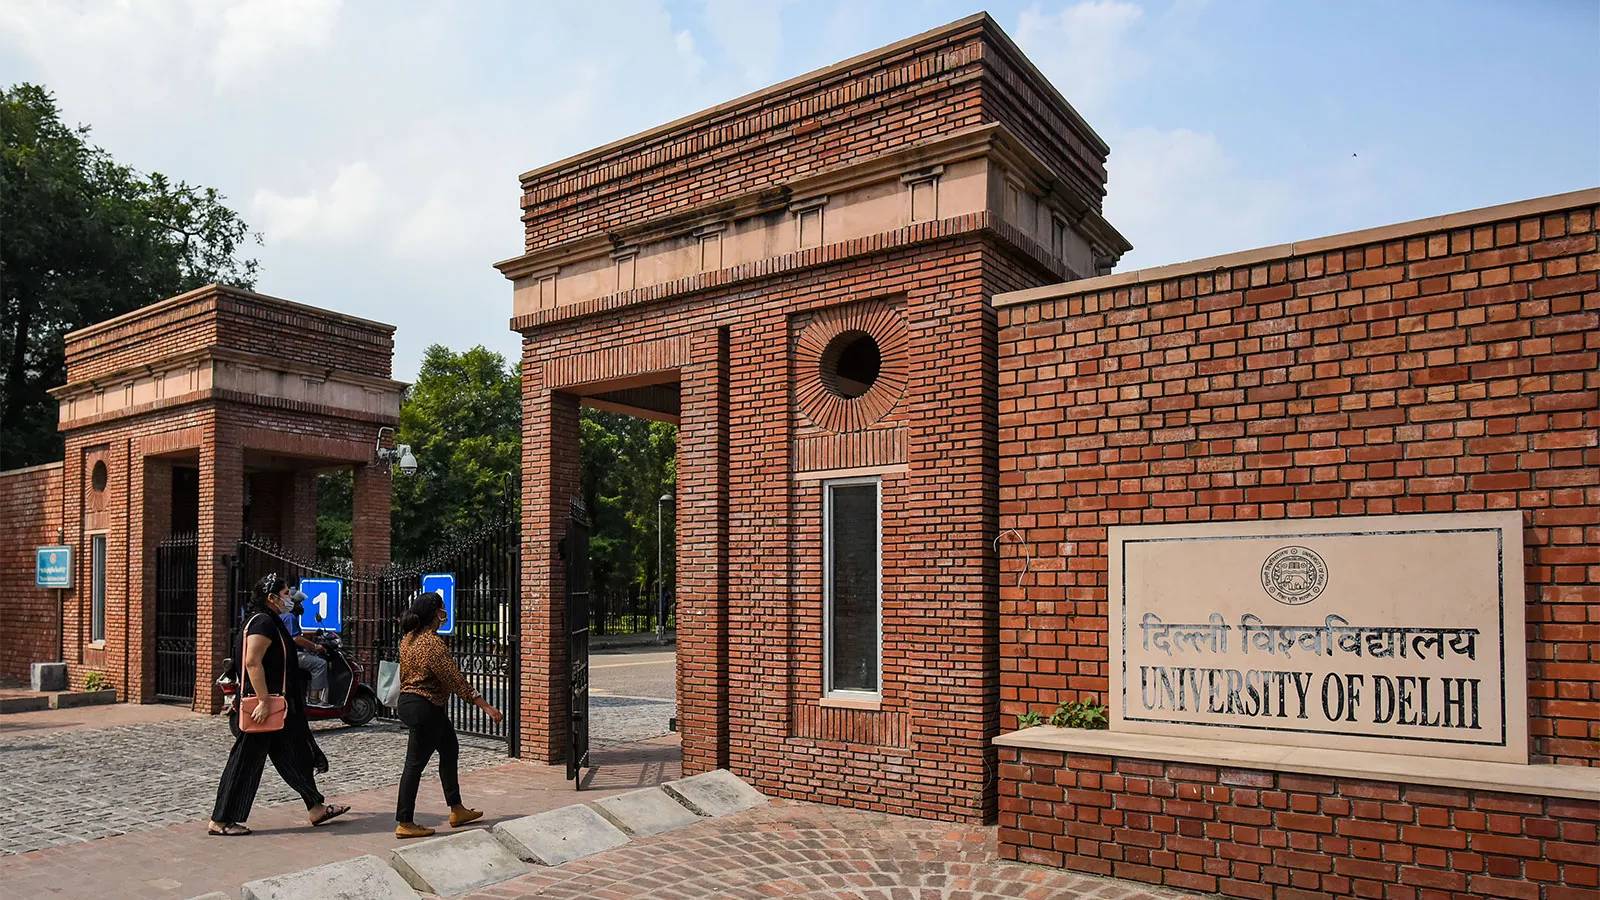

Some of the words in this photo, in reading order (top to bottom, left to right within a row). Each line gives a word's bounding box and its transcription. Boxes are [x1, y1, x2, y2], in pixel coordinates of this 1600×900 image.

[312, 592, 328, 619] 1
[1139, 612, 1231, 656] दिल्ली
[1237, 613, 1480, 661] विश्वविद्यालय
[1139, 665, 1313, 719] UNIVERSITY
[1321, 672, 1364, 722] OF
[1372, 674, 1482, 729] DELHI
